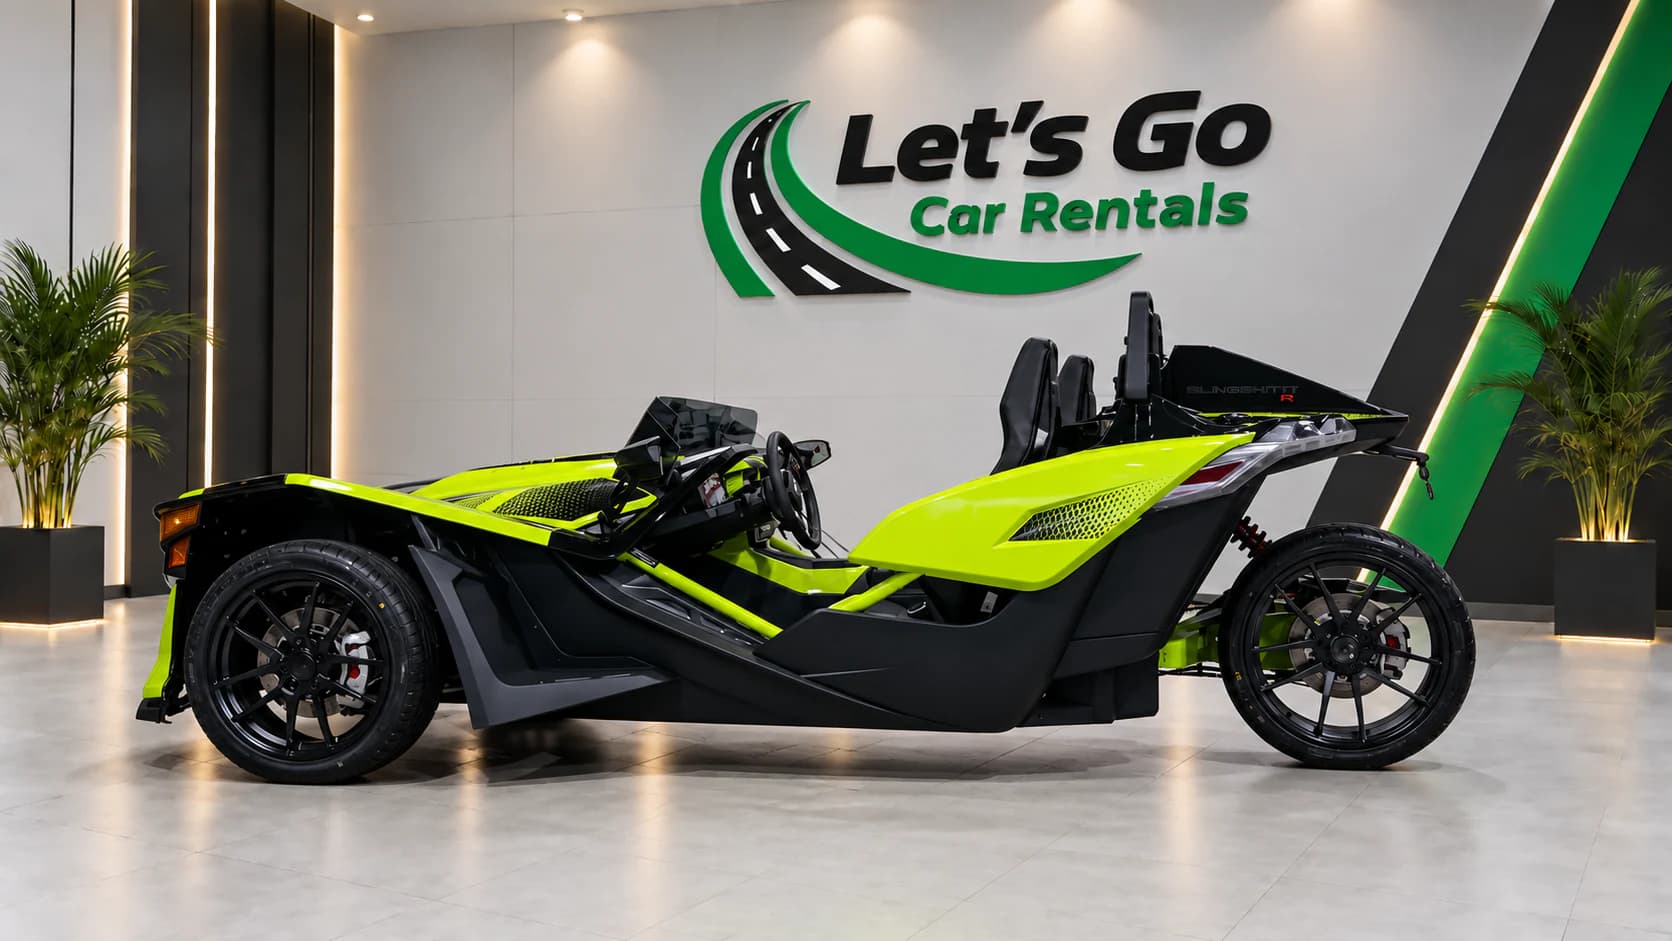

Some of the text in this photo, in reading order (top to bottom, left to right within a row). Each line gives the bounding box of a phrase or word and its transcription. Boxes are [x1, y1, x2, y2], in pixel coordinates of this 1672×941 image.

[1113, 91, 1271, 172] Go
[911, 182, 1249, 236] Car Rentals
[1280, 394, 1294, 402] R
